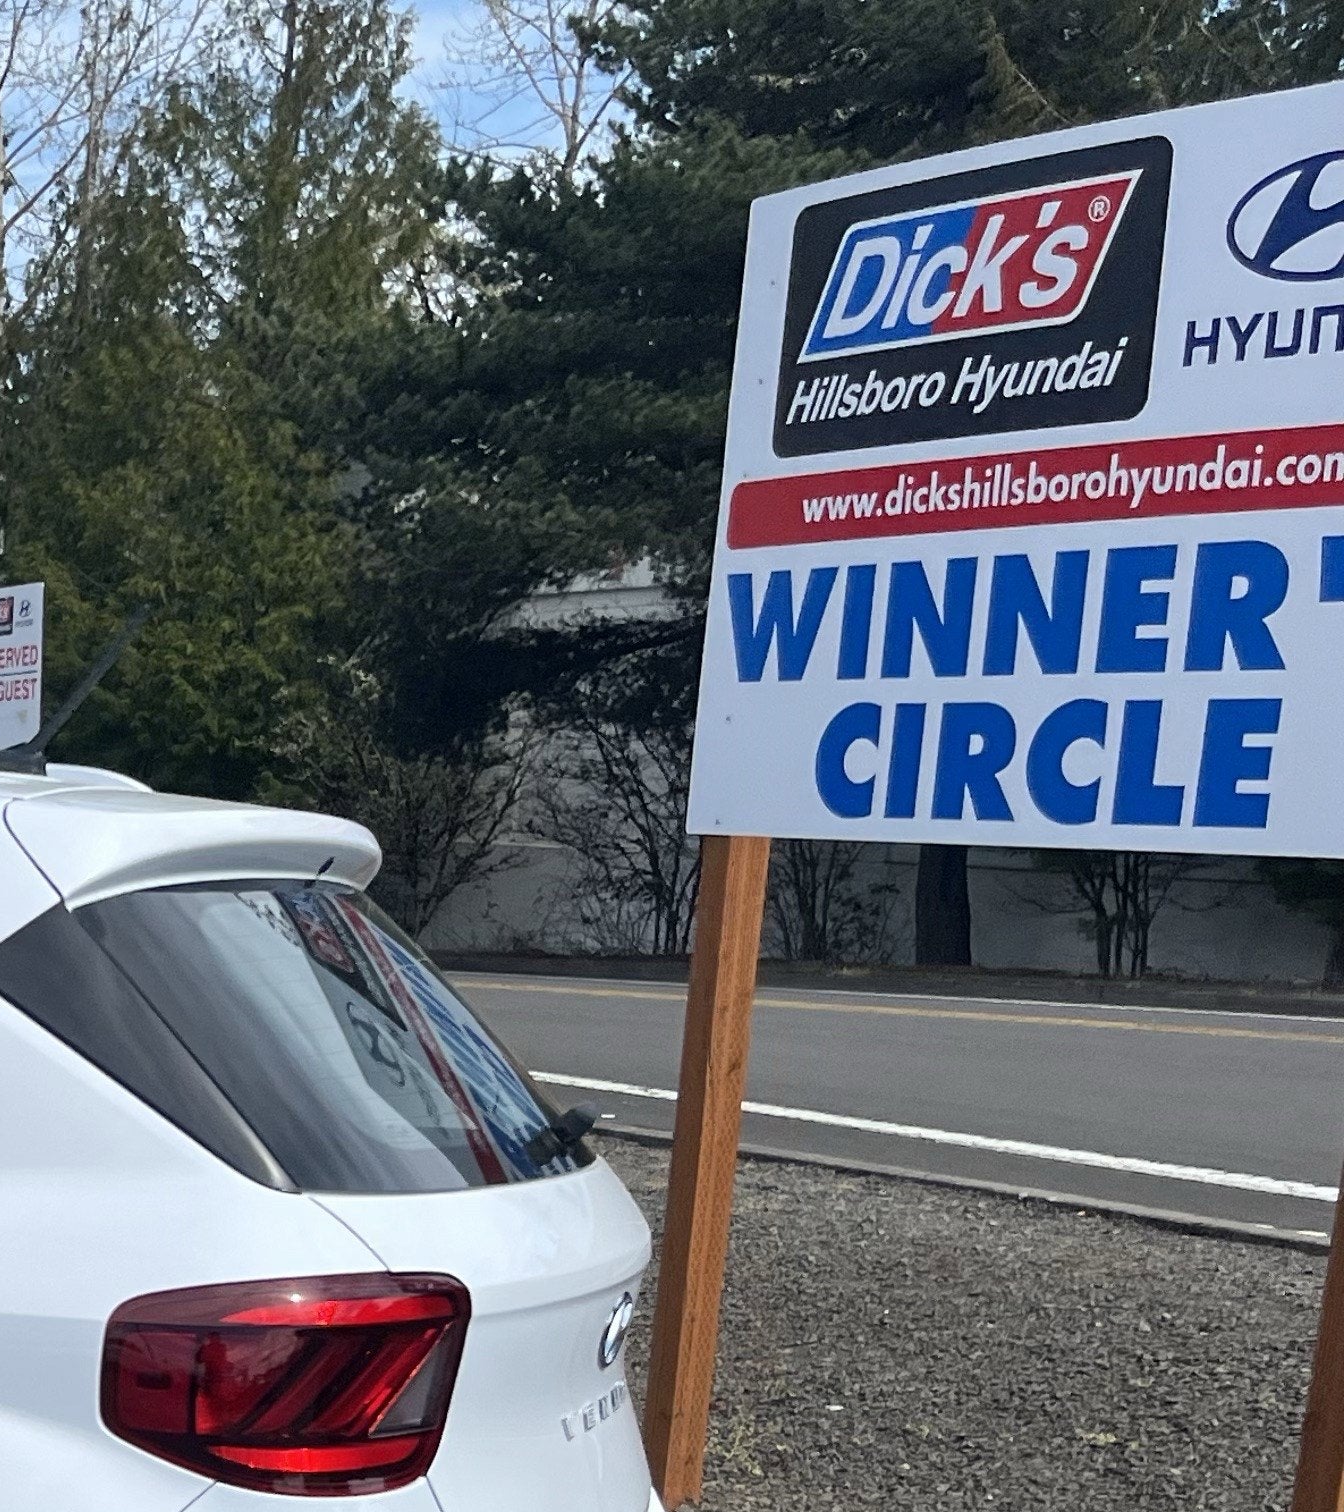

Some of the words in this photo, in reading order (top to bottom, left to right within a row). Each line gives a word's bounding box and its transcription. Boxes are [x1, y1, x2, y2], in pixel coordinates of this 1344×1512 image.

[822, 200, 1089, 338] Dick's
[786, 369, 945, 425] Hillsboro
[950, 336, 1128, 414] Hyundai
[814, 698, 1282, 829] CIRCLE
